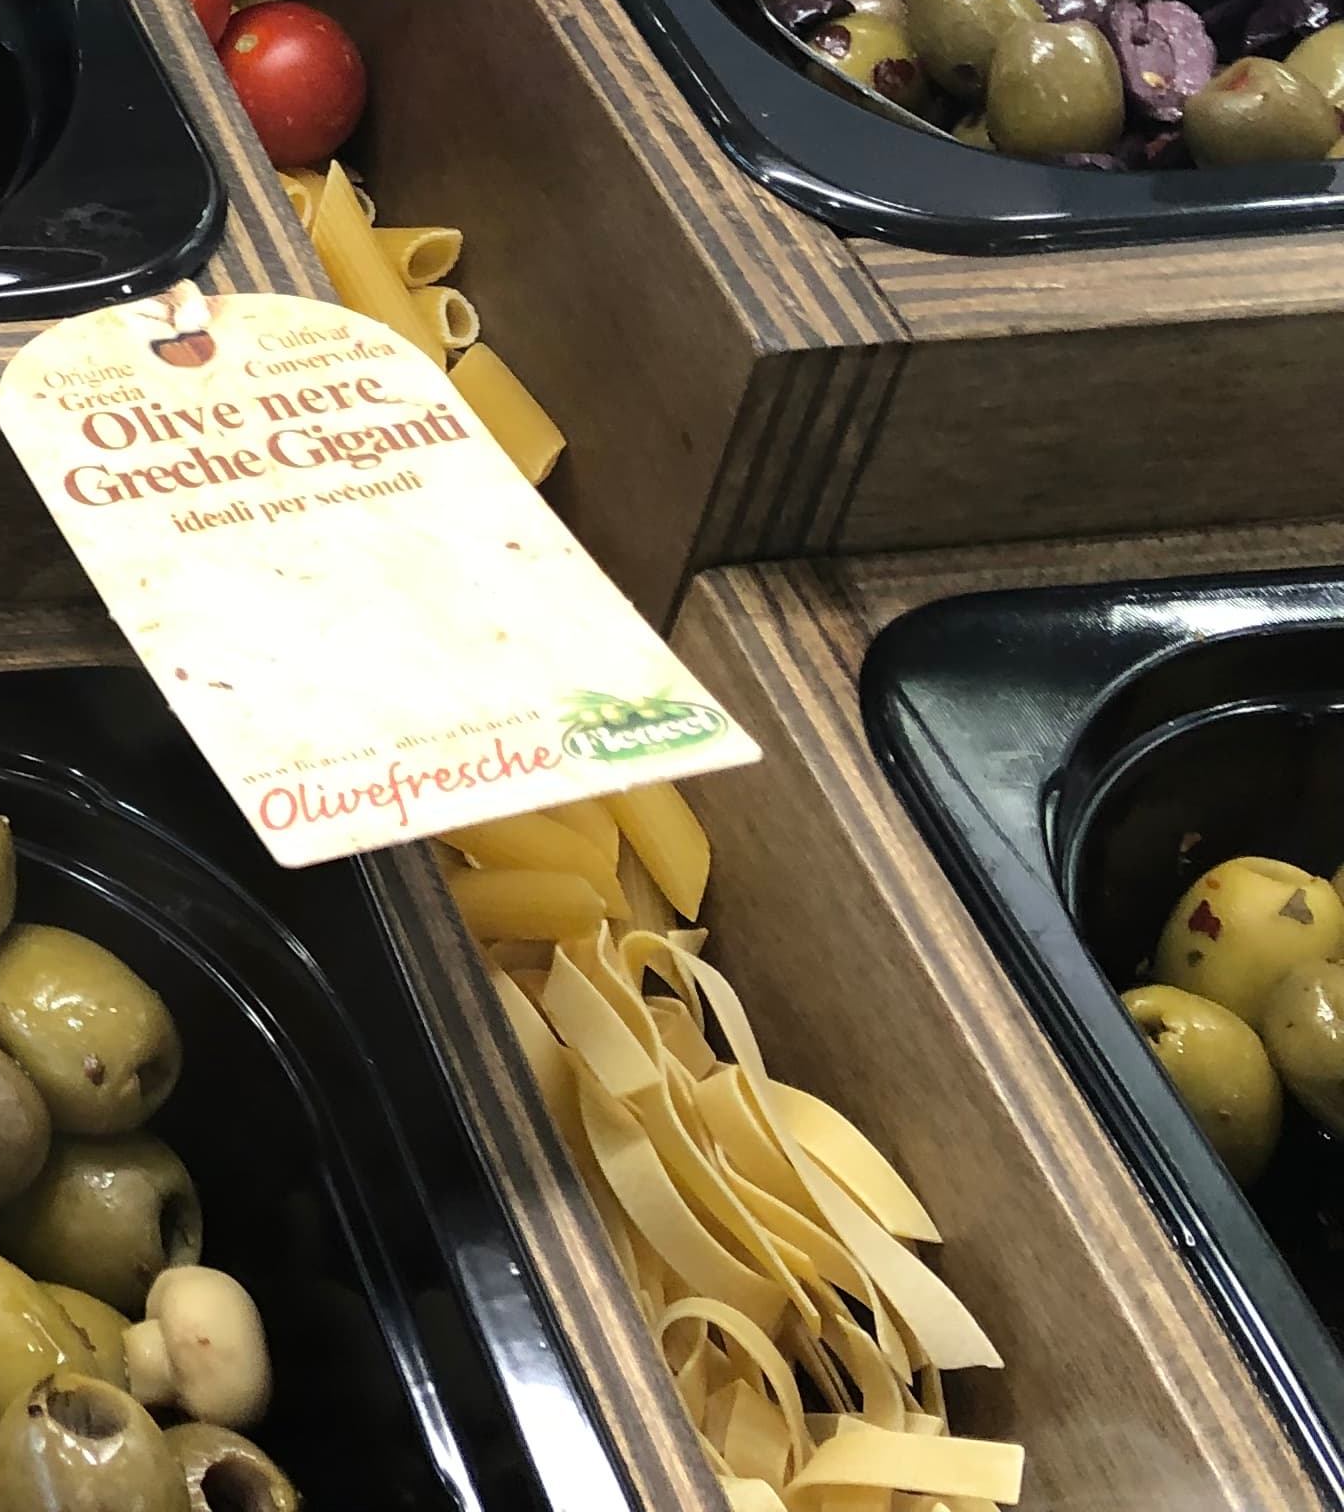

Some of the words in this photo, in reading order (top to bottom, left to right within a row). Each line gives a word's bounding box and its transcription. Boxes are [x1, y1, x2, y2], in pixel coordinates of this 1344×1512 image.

[258, 324, 353, 352] Cultivar
[43, 359, 136, 391] Origine
[57, 384, 147, 412] Grecia
[81, 401, 245, 451] Olive
[254, 374, 389, 422] nere
[62, 446, 268, 507] Greche
[266, 402, 472, 472] Giganti
[170, 500, 256, 535] ideali
[258, 494, 310, 524] per
[315, 469, 425, 507] secondi
[258, 737, 563, 832] Olivefresche
